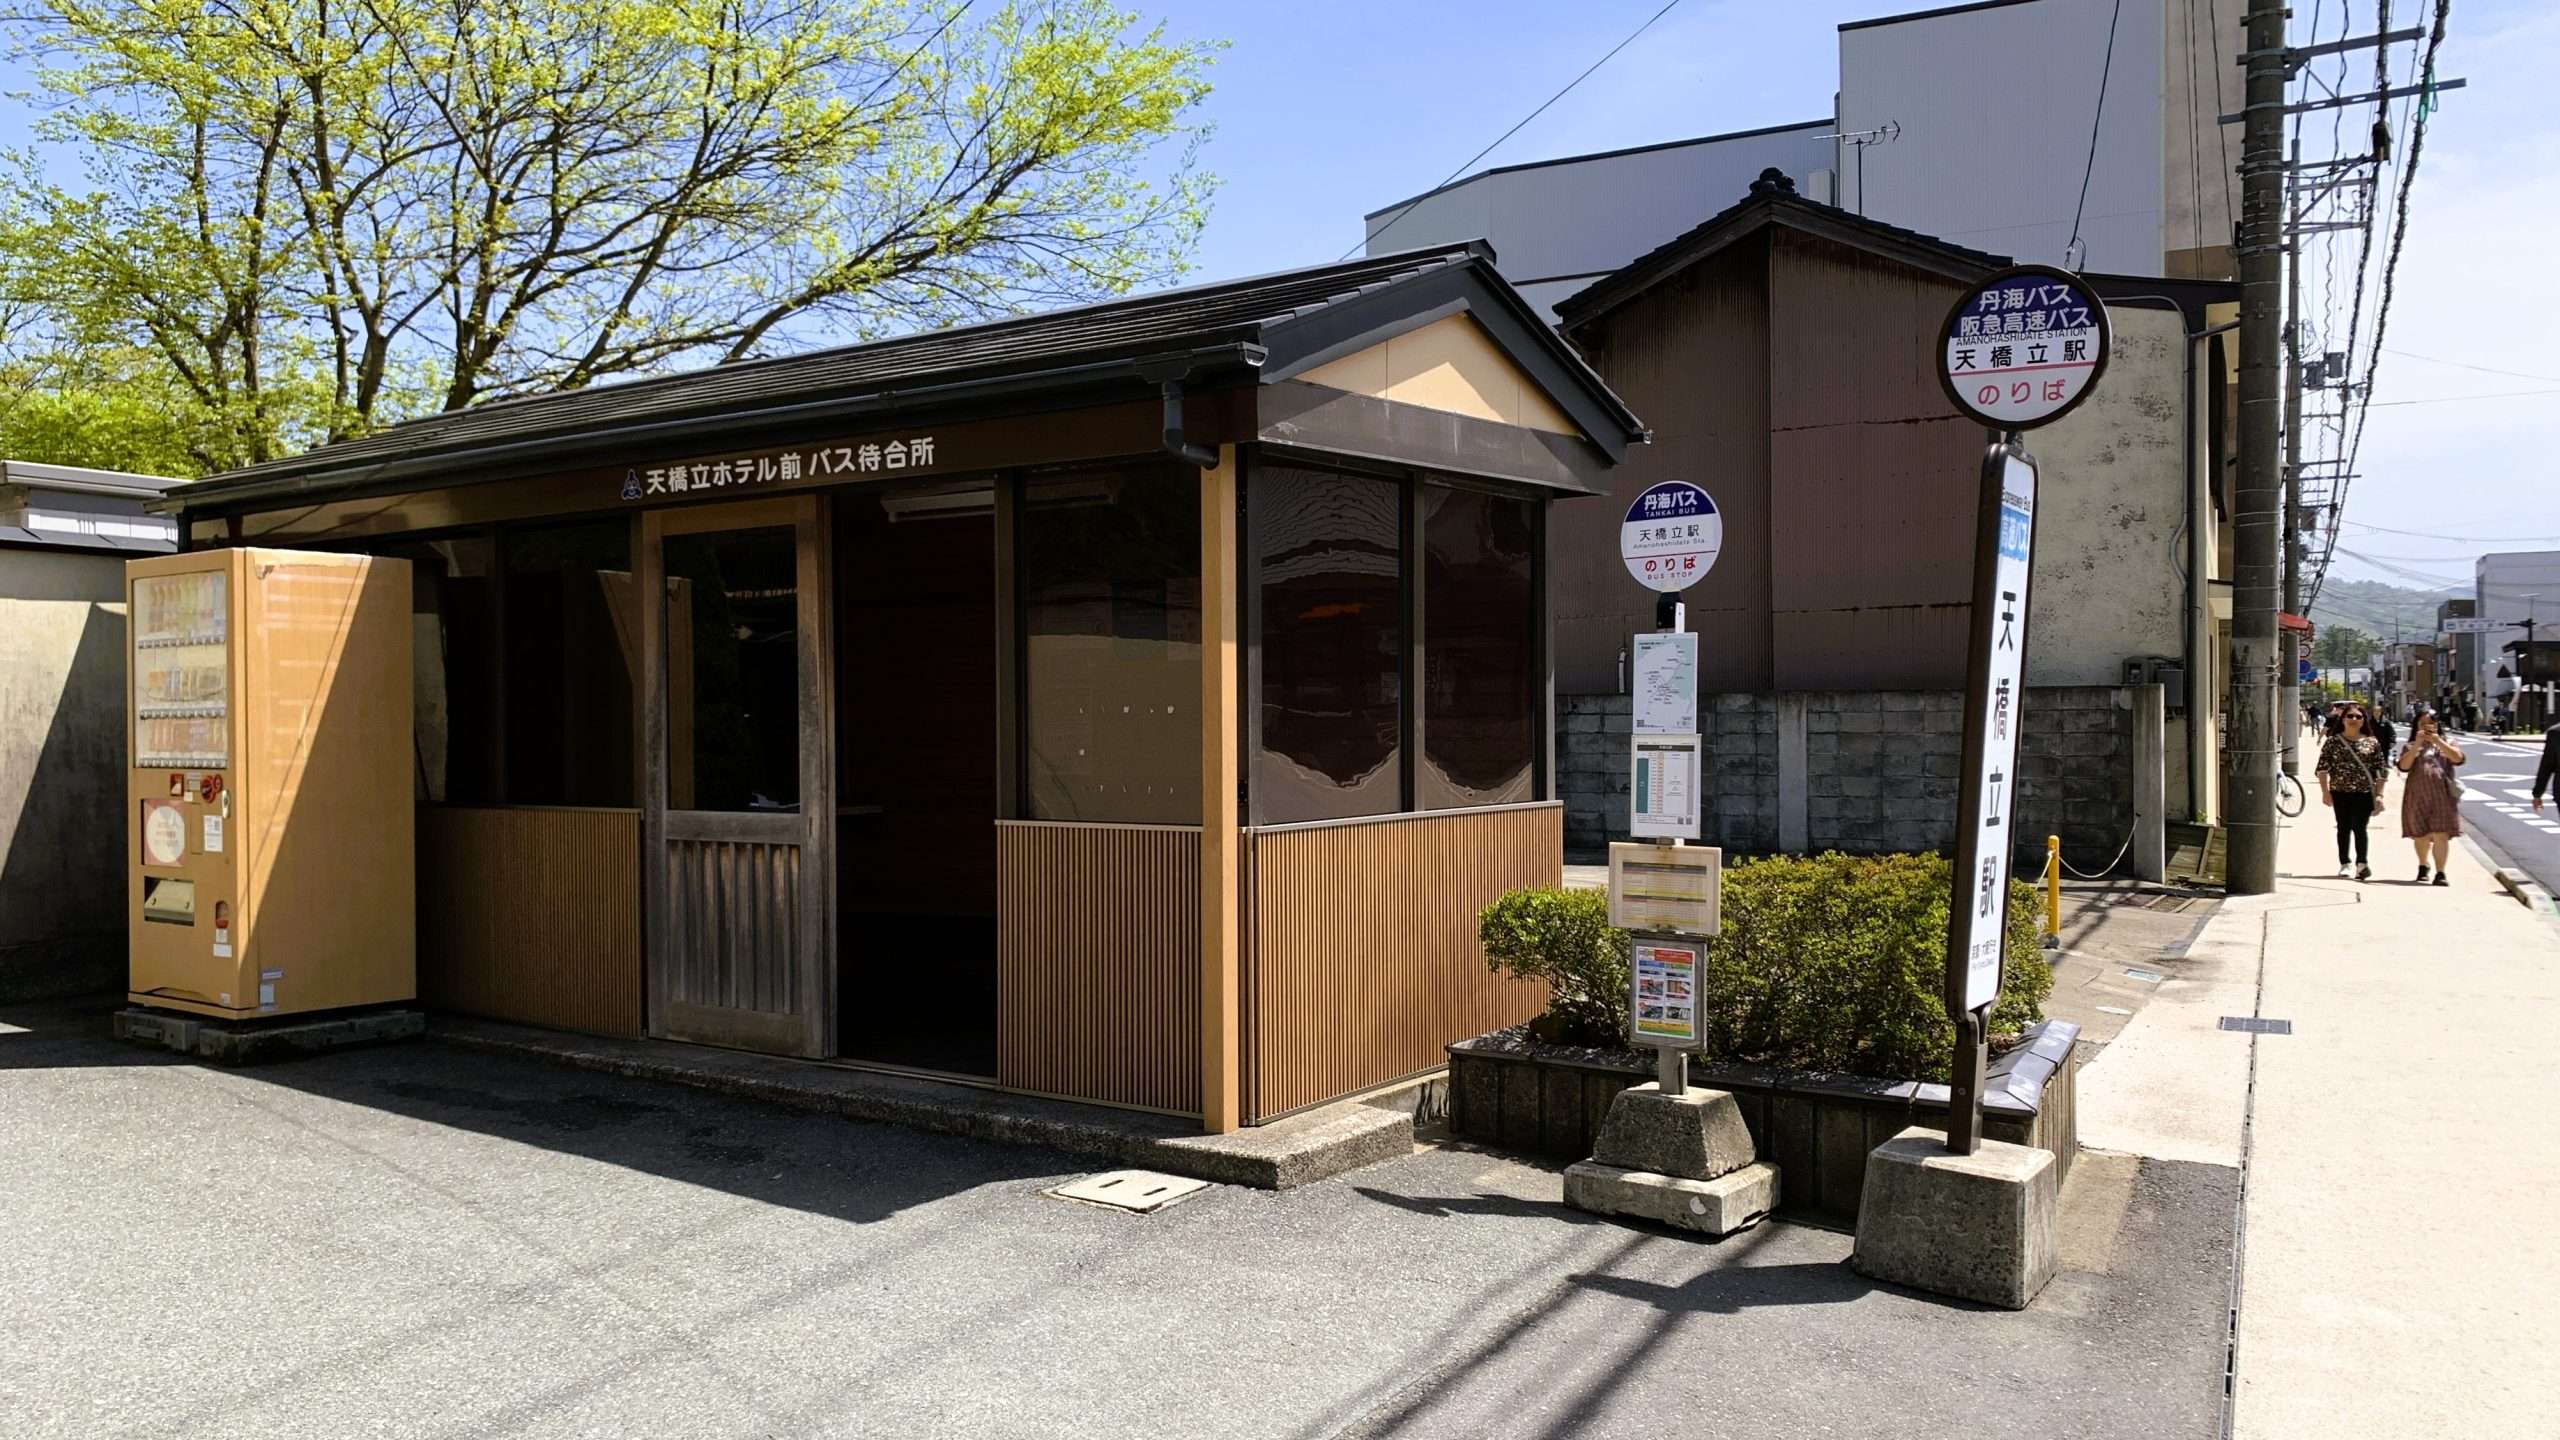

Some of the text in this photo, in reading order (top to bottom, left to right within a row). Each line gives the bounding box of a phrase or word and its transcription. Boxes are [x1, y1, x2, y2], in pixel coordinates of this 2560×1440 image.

[1979, 284, 2072, 312] 丹海バス
[1961, 307, 2091, 337] 阪急高速バス
[1956, 327, 2087, 346] AMANOHASHIDATE STATION
[1954, 339, 2086, 371] 天橋立駅
[1977, 379, 2066, 406] のりば
[645, 437, 935, 495] 天橋立ホテル前 バス待合所
[1644, 491, 1698, 511] 丹海バス
[1646, 507, 1696, 518] TANKAI BUS
[1639, 524, 1700, 542] 天橋立駅
[1645, 556, 1697, 572] のりば
[1670, 571, 1693, 579] STOP
[1979, 591, 2017, 919] 天橋立駅
